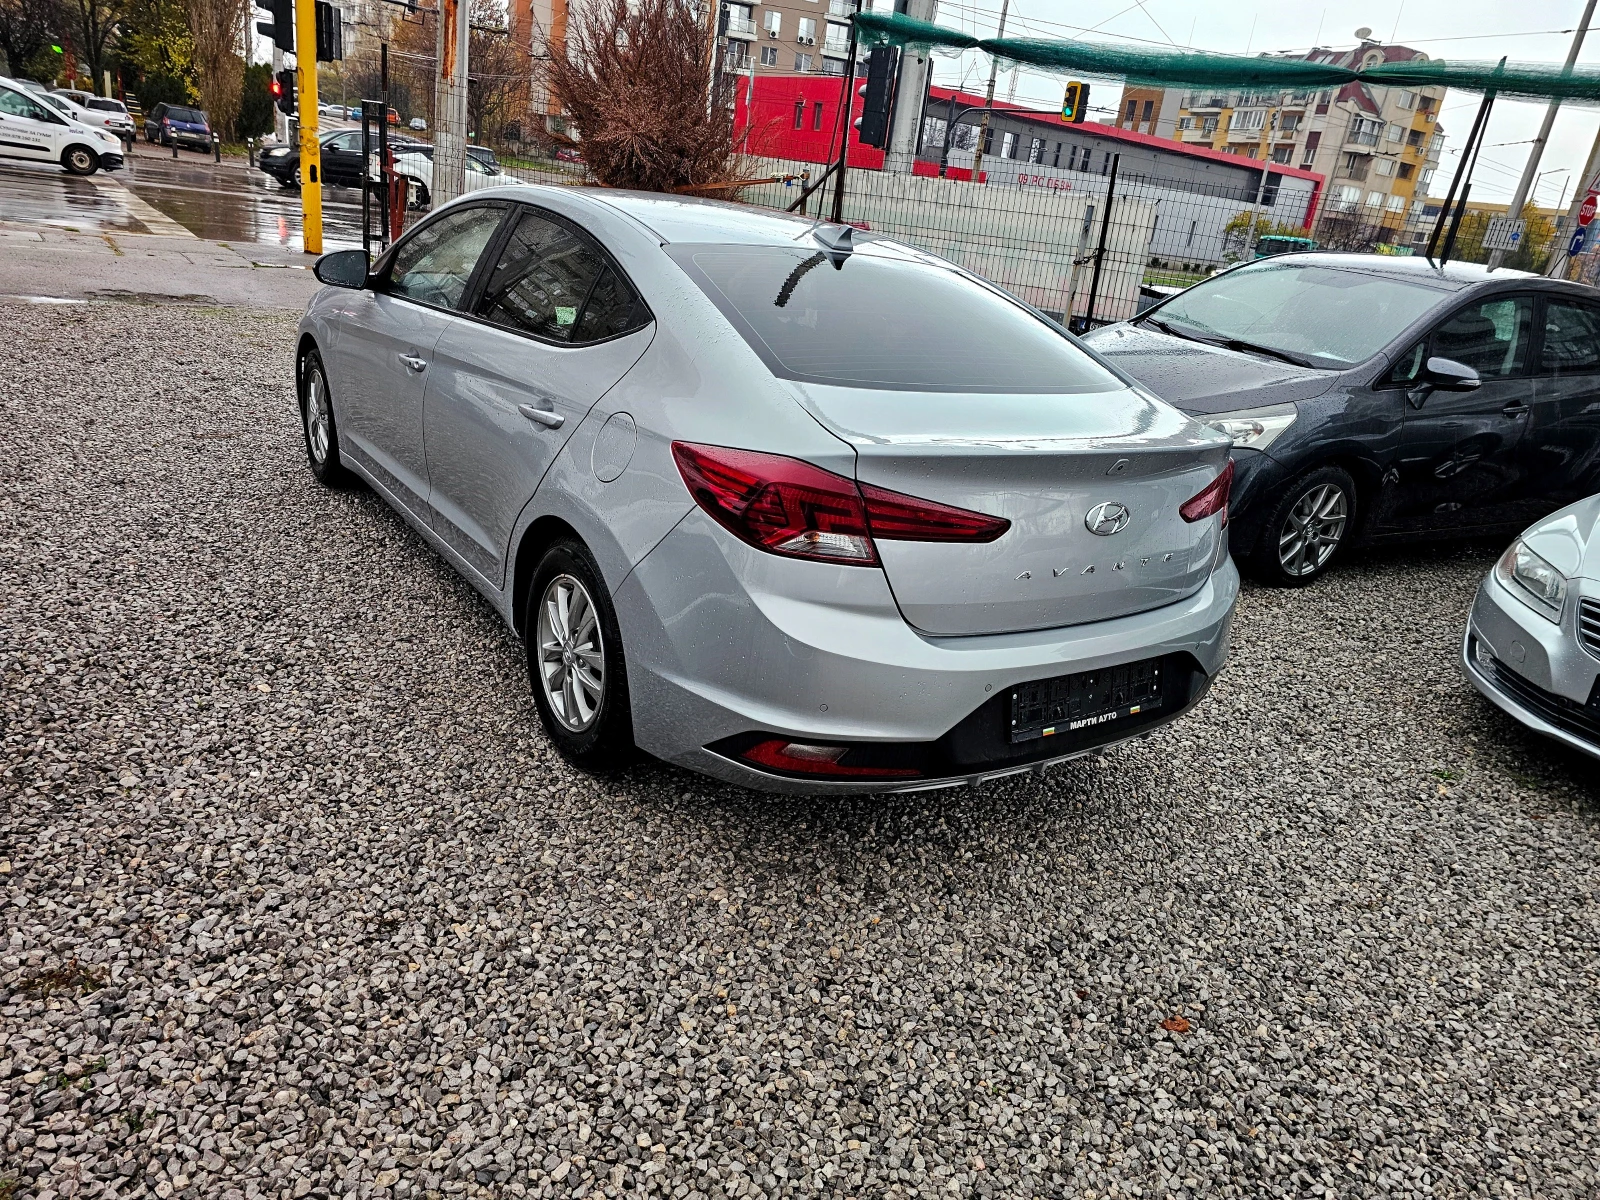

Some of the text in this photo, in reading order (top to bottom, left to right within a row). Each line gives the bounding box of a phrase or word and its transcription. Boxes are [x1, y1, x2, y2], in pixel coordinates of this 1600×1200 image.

[1018, 172, 1028, 185] 09
[1580, 203, 1597, 217] STOP
[1013, 552, 1174, 581] AVANTE
[1070, 711, 1117, 730] МАРТИ АУТО
